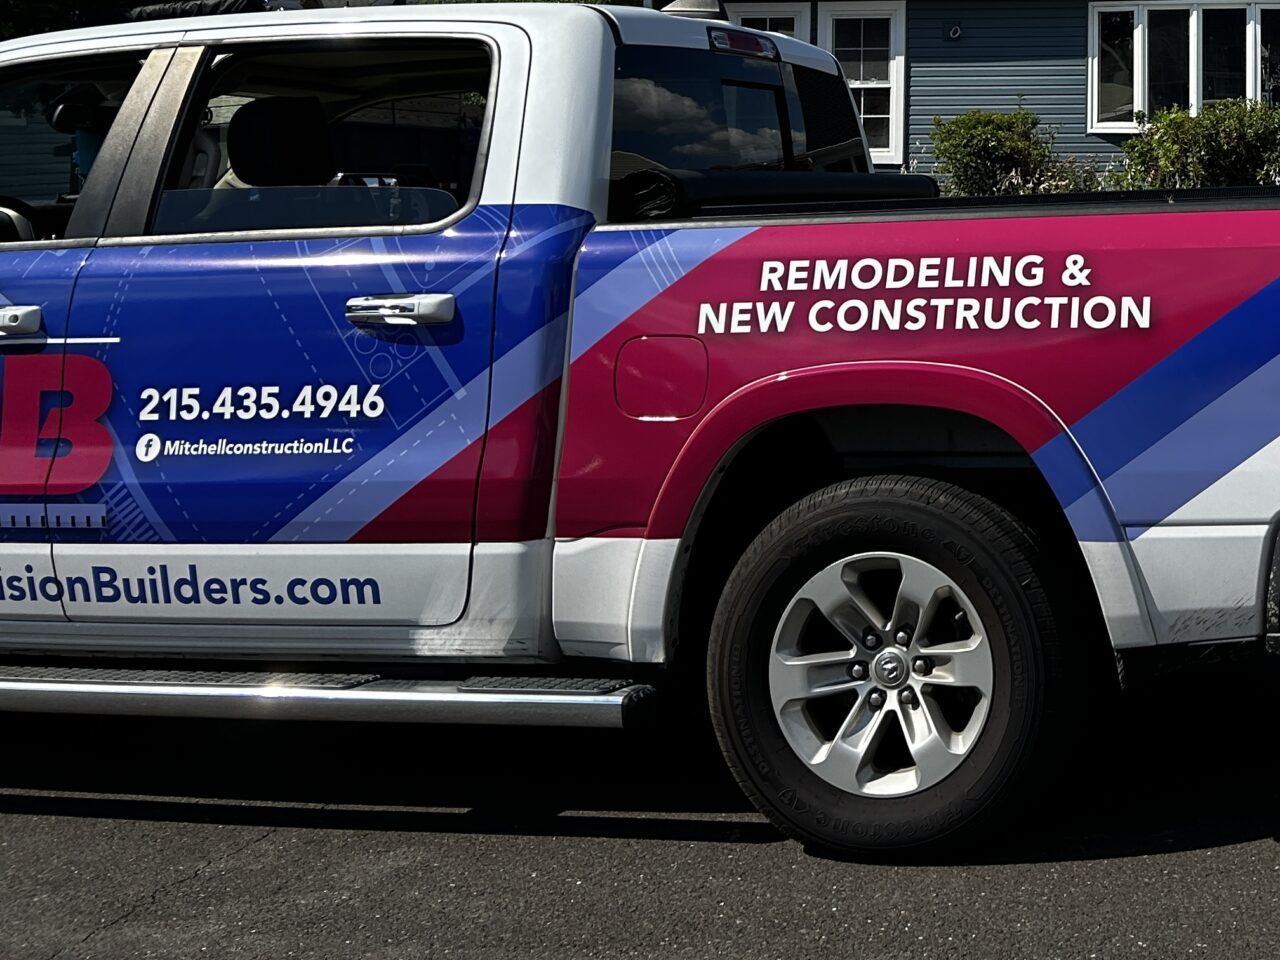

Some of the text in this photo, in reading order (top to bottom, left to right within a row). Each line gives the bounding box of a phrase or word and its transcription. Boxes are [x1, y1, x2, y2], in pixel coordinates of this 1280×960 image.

[760, 254, 1092, 291] REMODELING &
[698, 295, 1152, 334] NEW CONSTRUCTION
[139, 384, 385, 421] 215.435.4946
[0, 354, 113, 495] B
[163, 437, 354, 457] MitchellconstructionLLC
